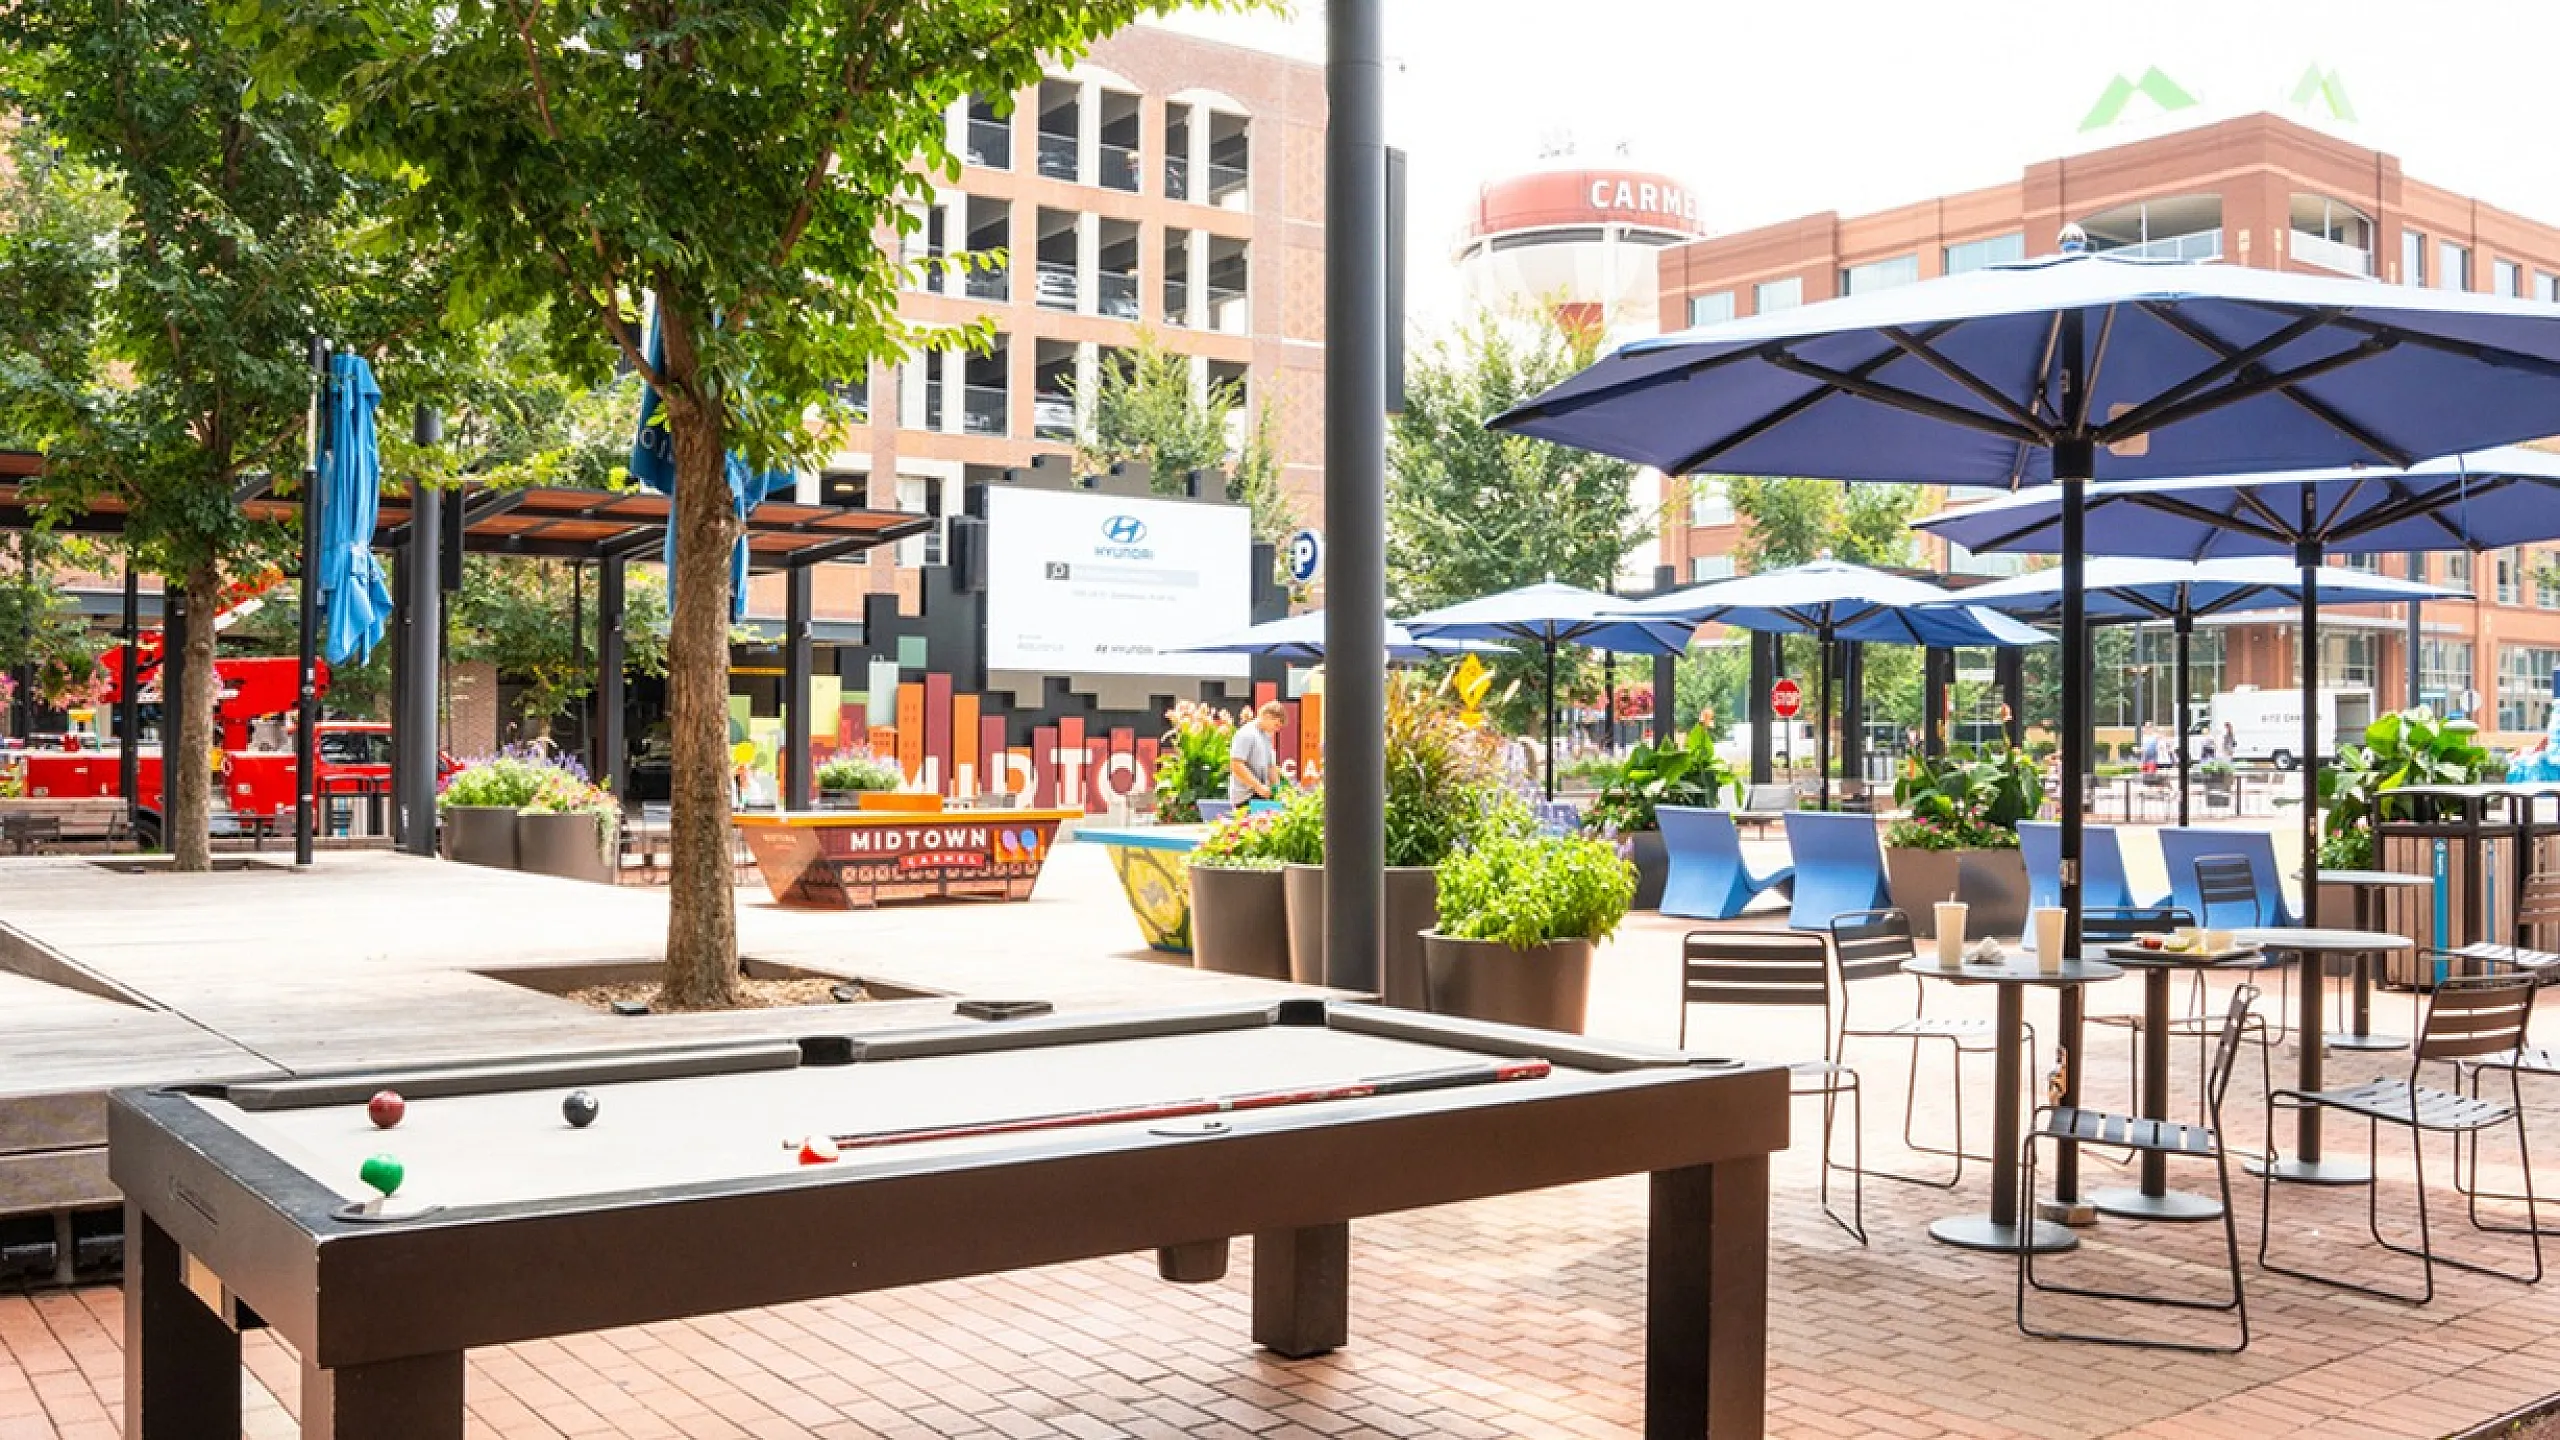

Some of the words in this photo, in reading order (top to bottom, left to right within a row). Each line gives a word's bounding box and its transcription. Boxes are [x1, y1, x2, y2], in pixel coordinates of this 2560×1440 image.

[1591, 179, 1699, 220] CARME
[1774, 691, 1799, 706] STOP
[886, 748, 1148, 810] MIDTO
[851, 828, 987, 850] MIDTOWN
